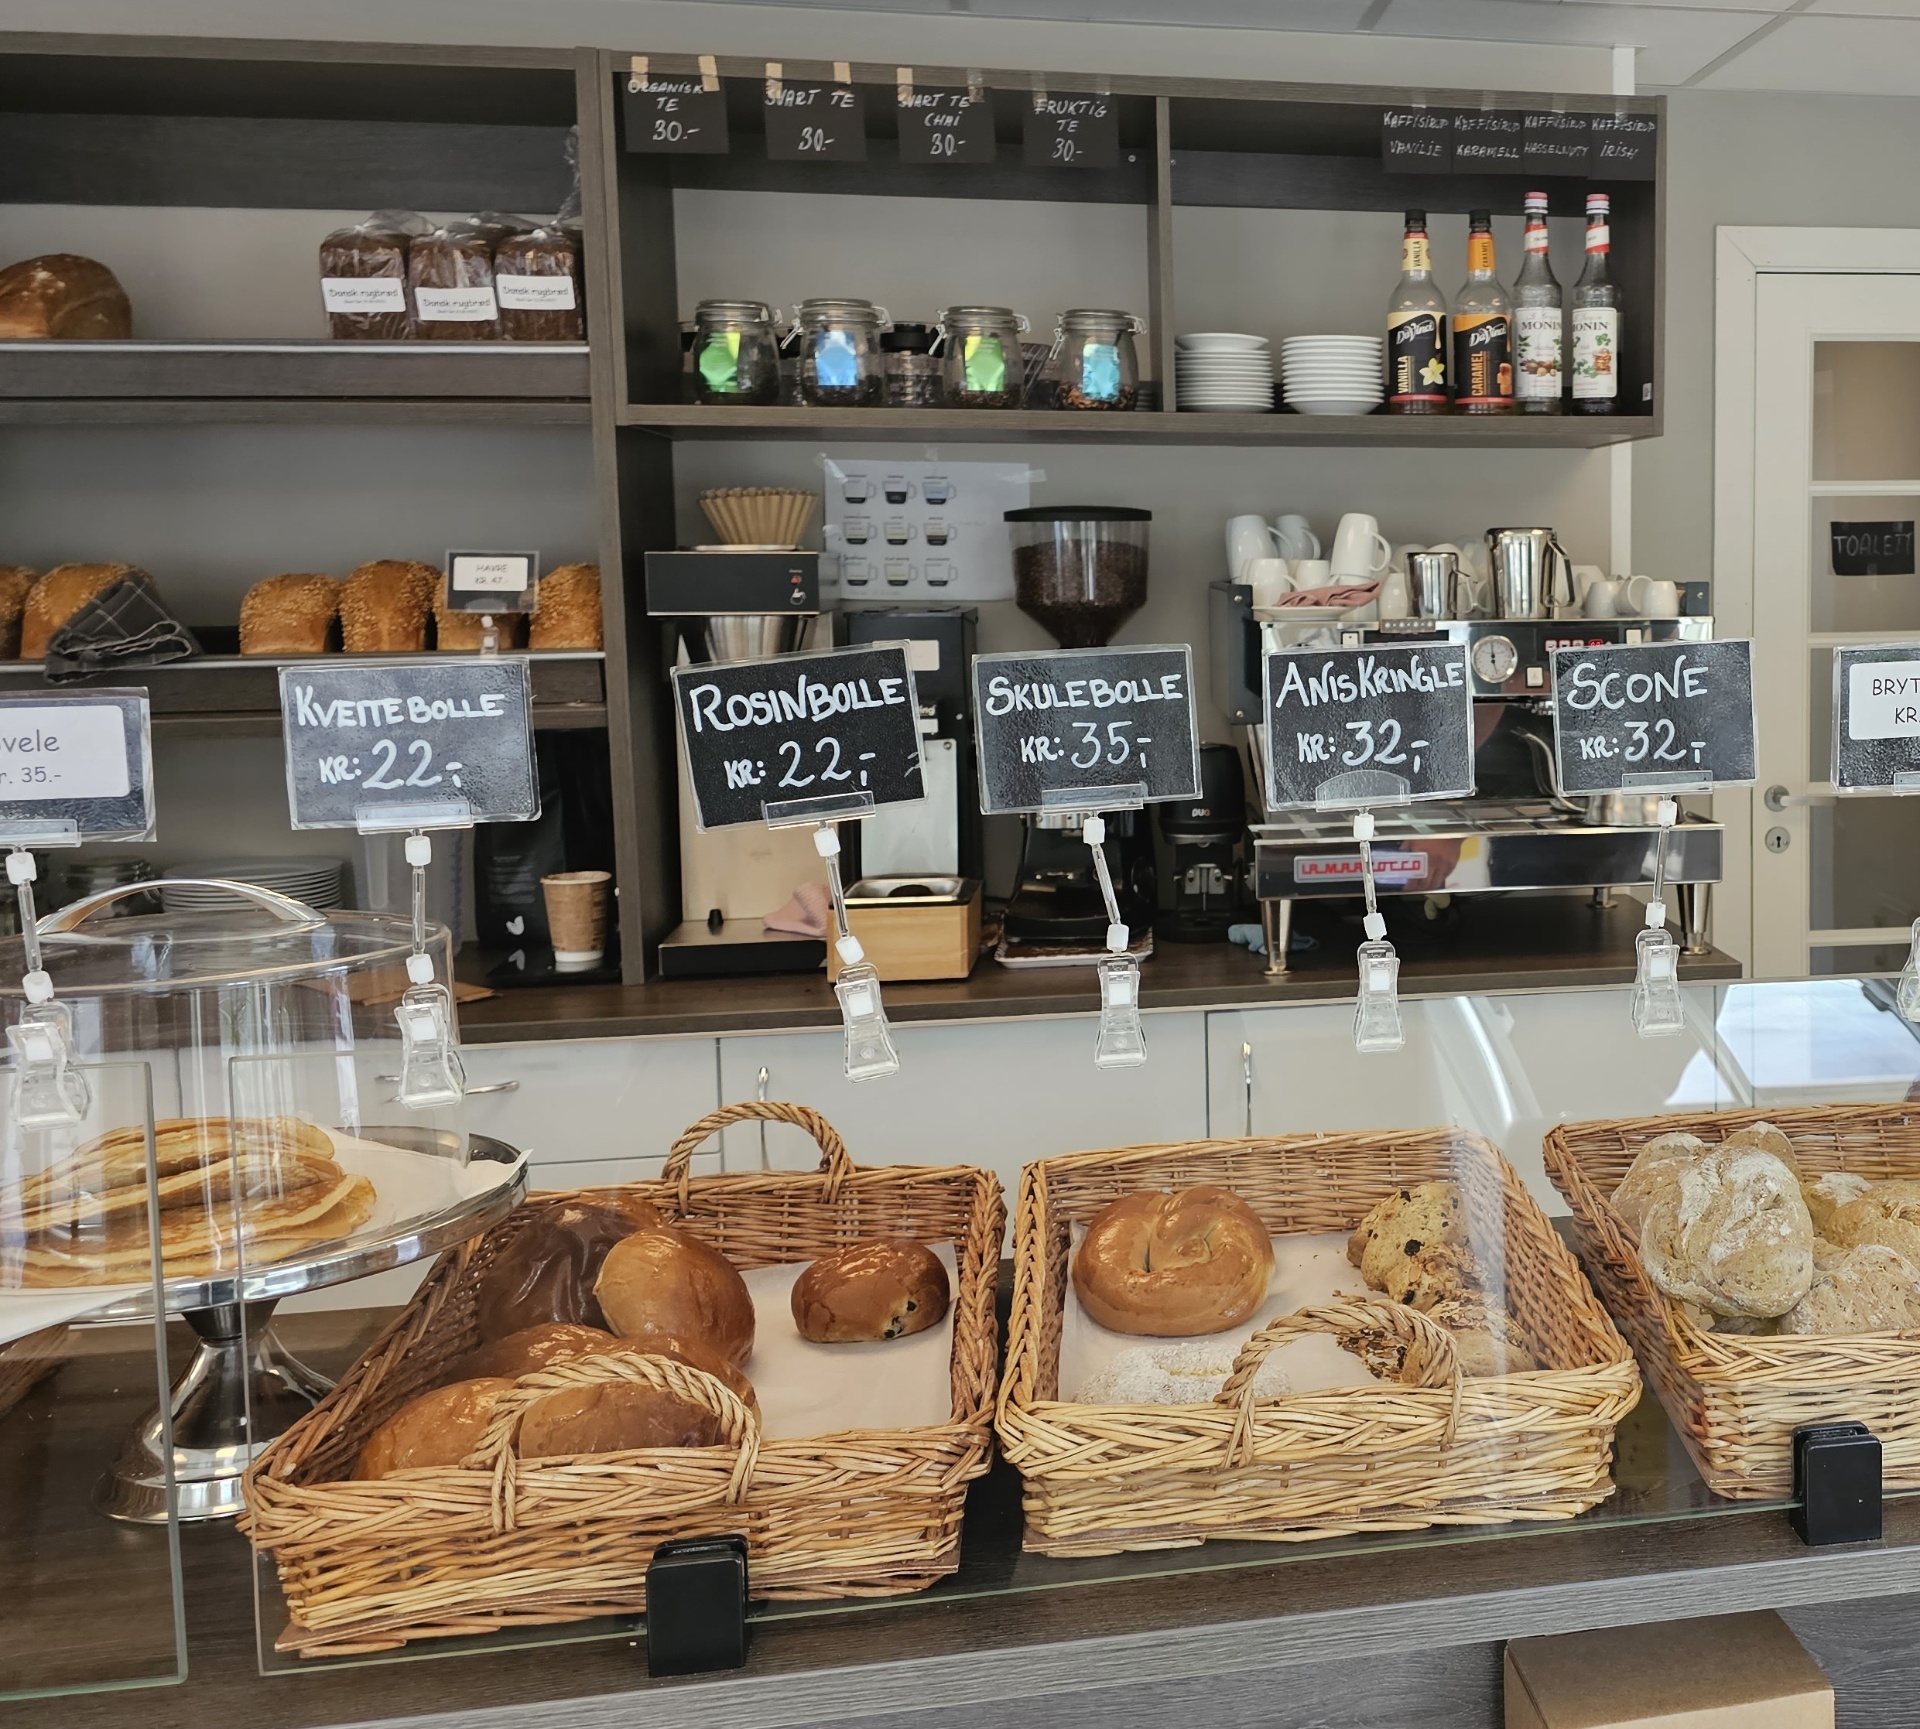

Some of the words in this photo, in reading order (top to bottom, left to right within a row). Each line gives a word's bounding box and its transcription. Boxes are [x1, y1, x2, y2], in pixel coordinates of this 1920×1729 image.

[655, 96, 680, 112] TE
[764, 88, 822, 108] SVART
[830, 90, 855, 108] TE
[949, 94, 971, 108] TE
[1033, 98, 1108, 118] FRUKTIG
[1056, 118, 1080, 132] TE
[1390, 140, 1443, 157] VANILJE
[1456, 144, 1520, 159] KARAMELL
[1412, 240, 1422, 268] VANILLA
[1481, 241, 1490, 268] CARAMEL
[1396, 320, 1435, 345] DaVinci
[1469, 324, 1508, 347] DaVinci
[1573, 321, 1608, 332] ONIN
[1397, 355, 1409, 393] VANILLA
[1471, 349, 1484, 397] CARAMEL
[1833, 532, 1913, 557] TOALETT
[985, 673, 1184, 716] SKULEBOLLE
[1566, 654, 1709, 710] SCONE
[689, 674, 906, 733] ROSINBOLLE
[0, 729, 61, 753] vele
[1020, 735, 1065, 763] KR:
[1296, 732, 1337, 763] KR:
[1580, 735, 1620, 760] KR:
[21, 766, 62, 783] 35.-
[318, 754, 362, 785] KR:
[723, 759, 767, 790] KR:
